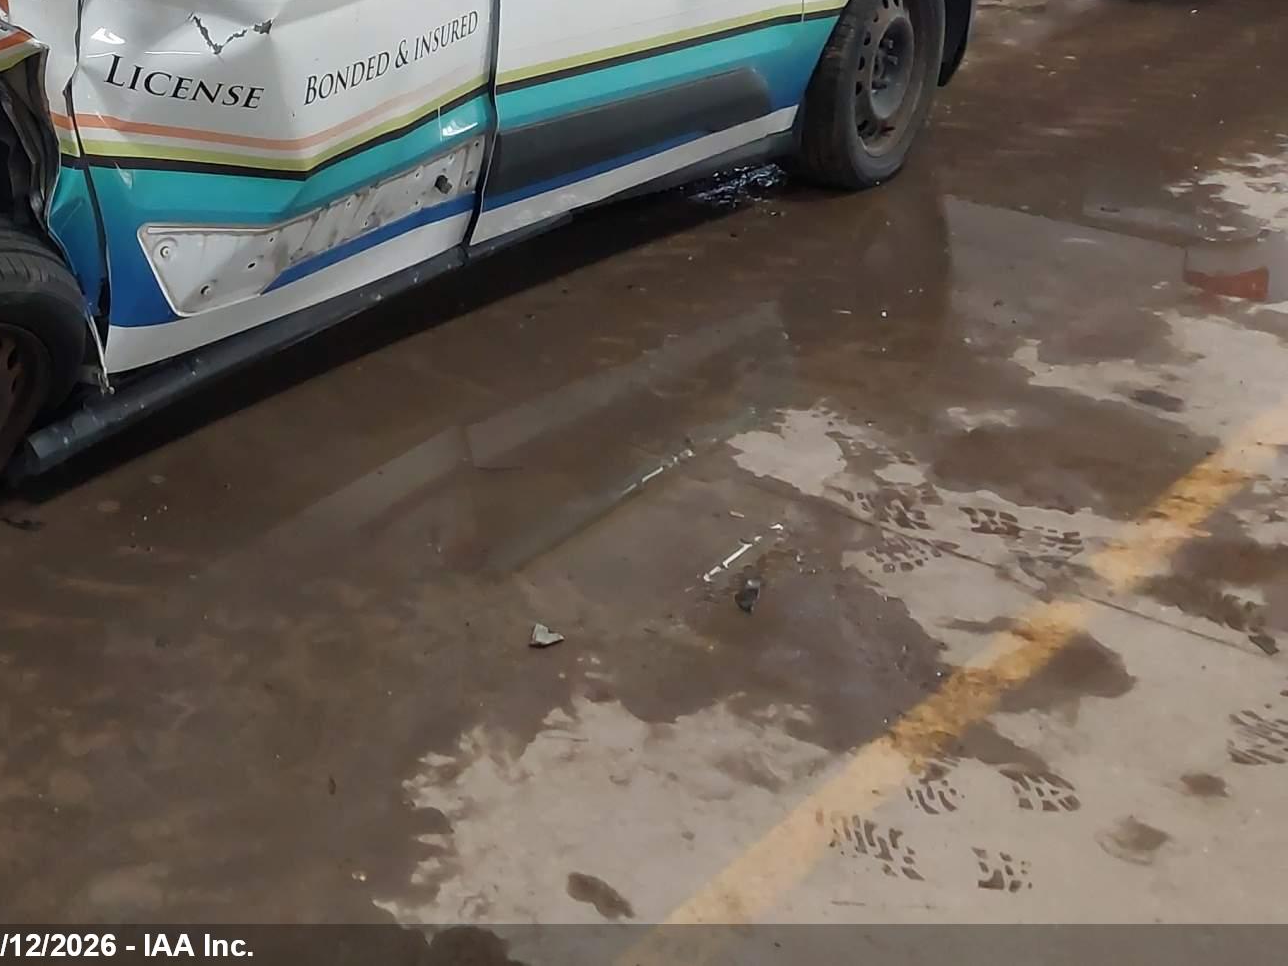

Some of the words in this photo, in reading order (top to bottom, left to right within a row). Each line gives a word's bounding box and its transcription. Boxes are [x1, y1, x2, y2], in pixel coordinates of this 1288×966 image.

[103, 54, 265, 110] LICENSE
[304, 52, 389, 106] BONDED
[395, 40, 409, 69] &
[414, 10, 479, 62] INSURED
